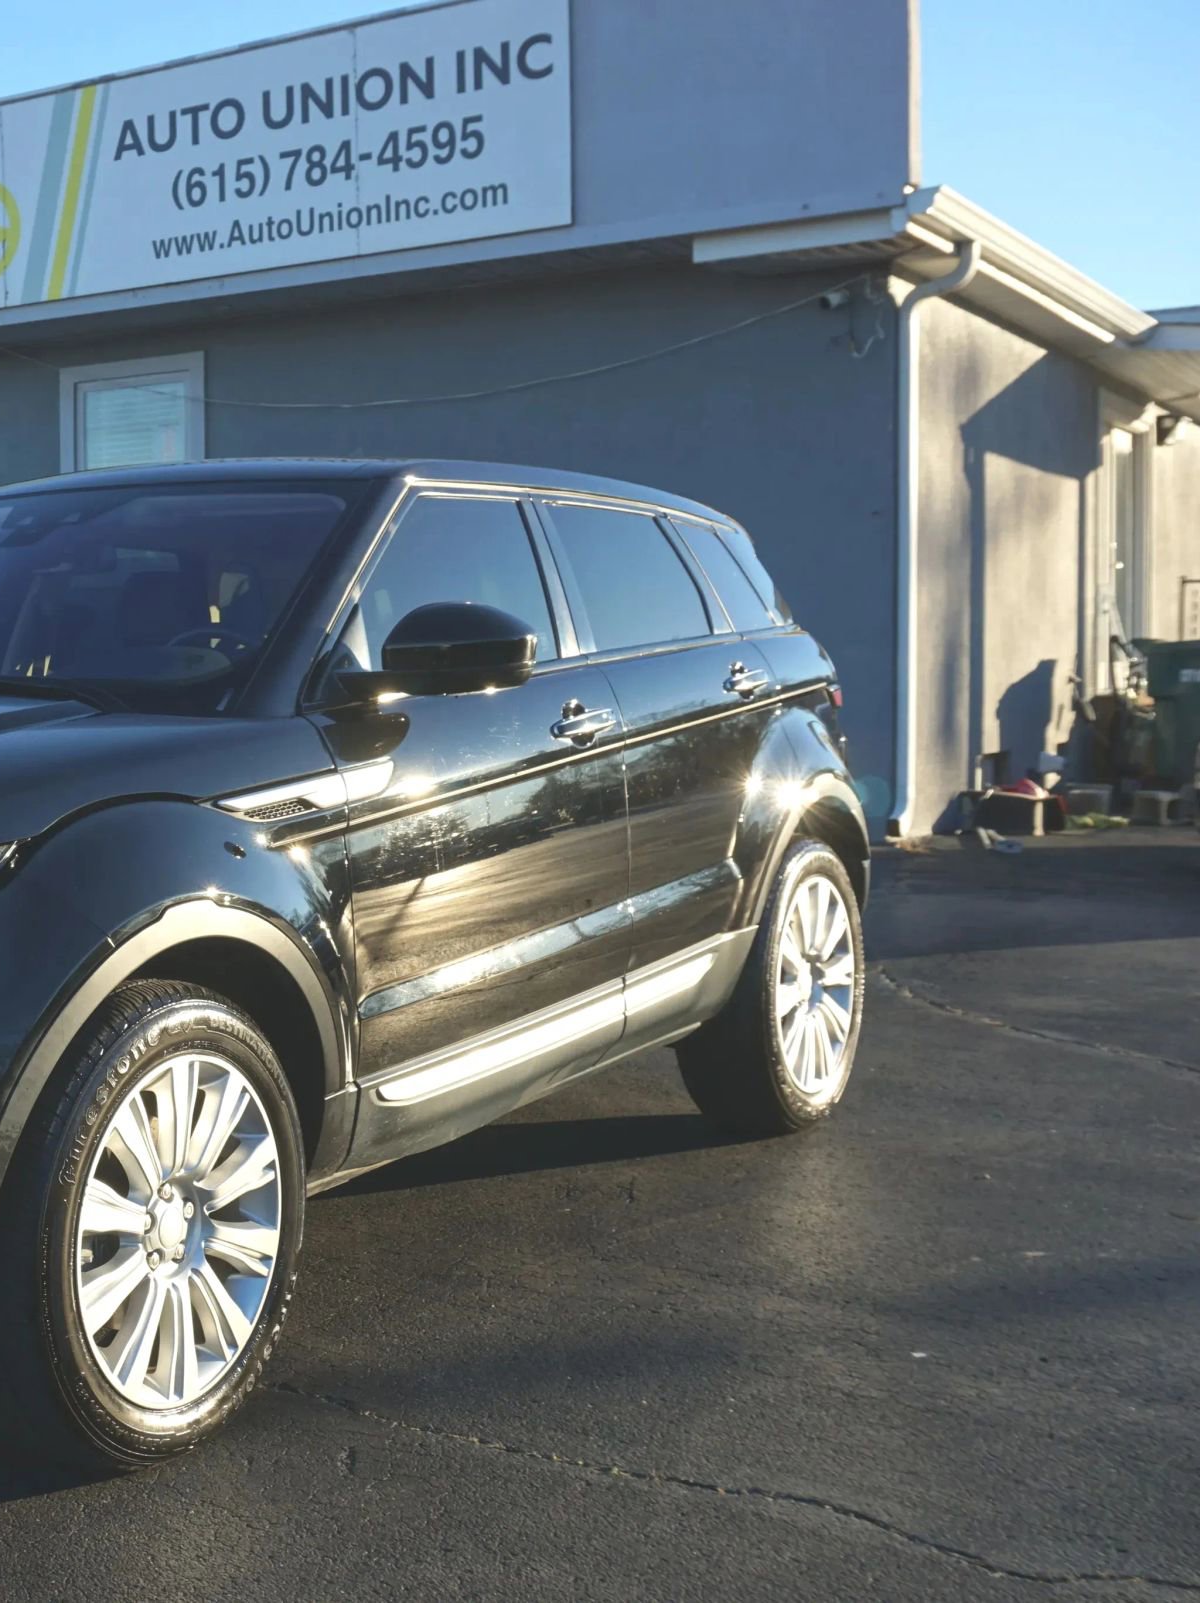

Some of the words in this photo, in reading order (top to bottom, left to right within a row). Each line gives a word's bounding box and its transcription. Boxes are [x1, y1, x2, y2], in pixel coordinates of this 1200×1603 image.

[113, 97, 245, 161] AUTO
[262, 56, 435, 130] UNION
[456, 32, 554, 94] INC
[152, 182, 508, 259] www.AutoUnionInc.com
